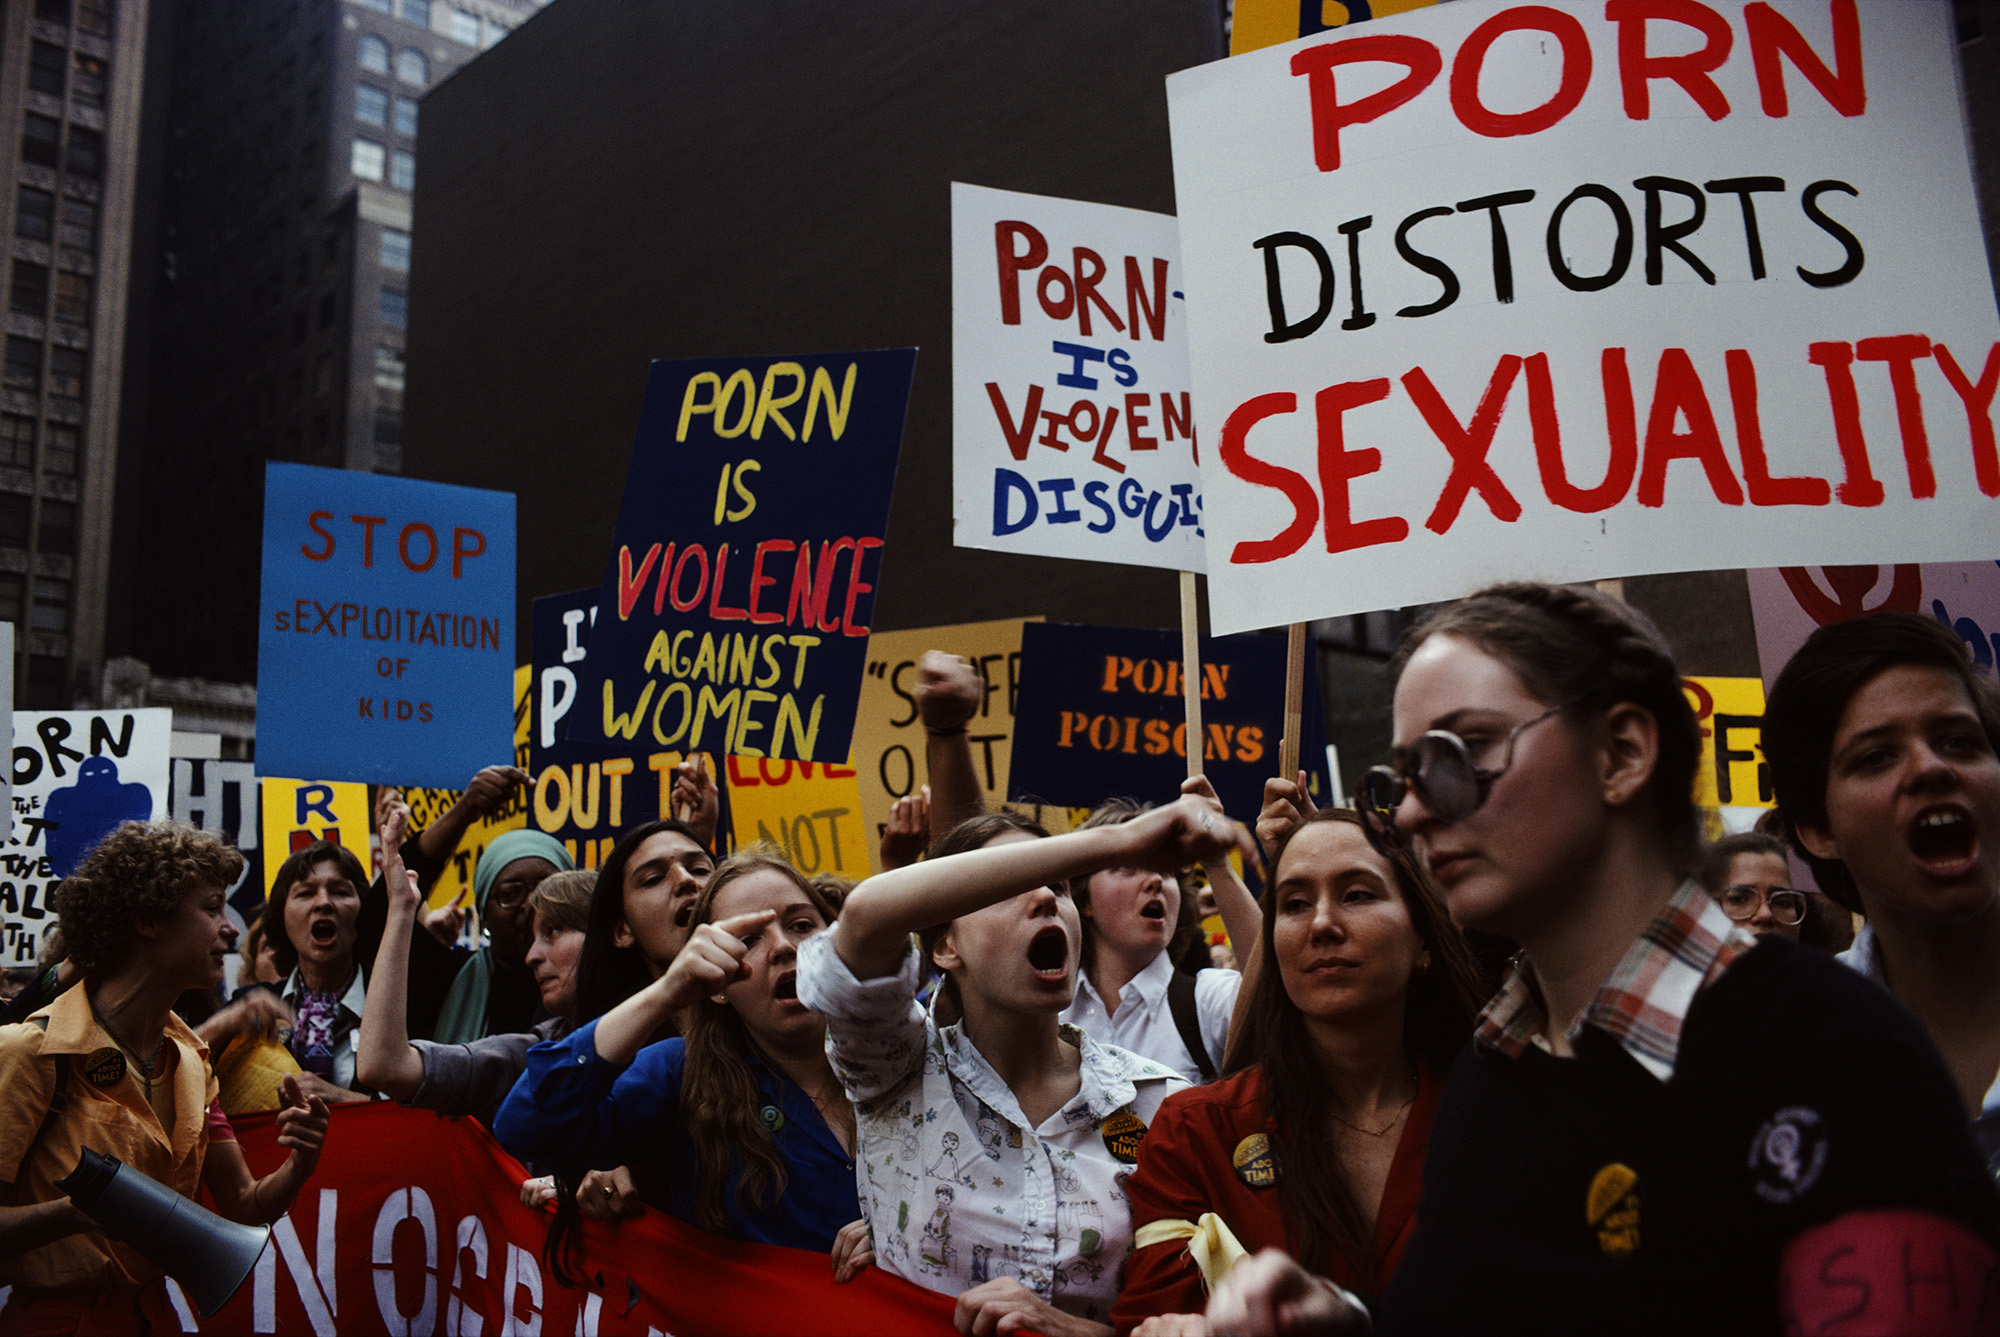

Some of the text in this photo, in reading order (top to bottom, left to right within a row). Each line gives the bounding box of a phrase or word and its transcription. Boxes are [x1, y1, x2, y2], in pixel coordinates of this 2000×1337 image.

[1290, 0, 1866, 172] PORN
[1253, 176, 1865, 343] DISTORTS
[1053, 341, 1138, 390] IS
[676, 362, 857, 443] PORN
[985, 382, 1199, 473] VIOLEN
[1219, 335, 2000, 564] SEXUALITY
[714, 459, 761, 525] IS
[992, 468, 1205, 542] DISGUI
[300, 510, 487, 578] STOP
[618, 536, 884, 637] VIOLENCE
[376, 657, 410, 678] OF
[644, 629, 821, 689] AGAINST
[1102, 655, 1230, 700] PORN
[358, 696, 433, 723] KIDS
[602, 679, 825, 761] WOMEN
[1057, 710, 1264, 763] POISONS
[12, 714, 134, 786] ORN
[878, 733, 1007, 799] OT
[534, 764, 634, 833] OUT
[1, 853, 54, 880] THE
